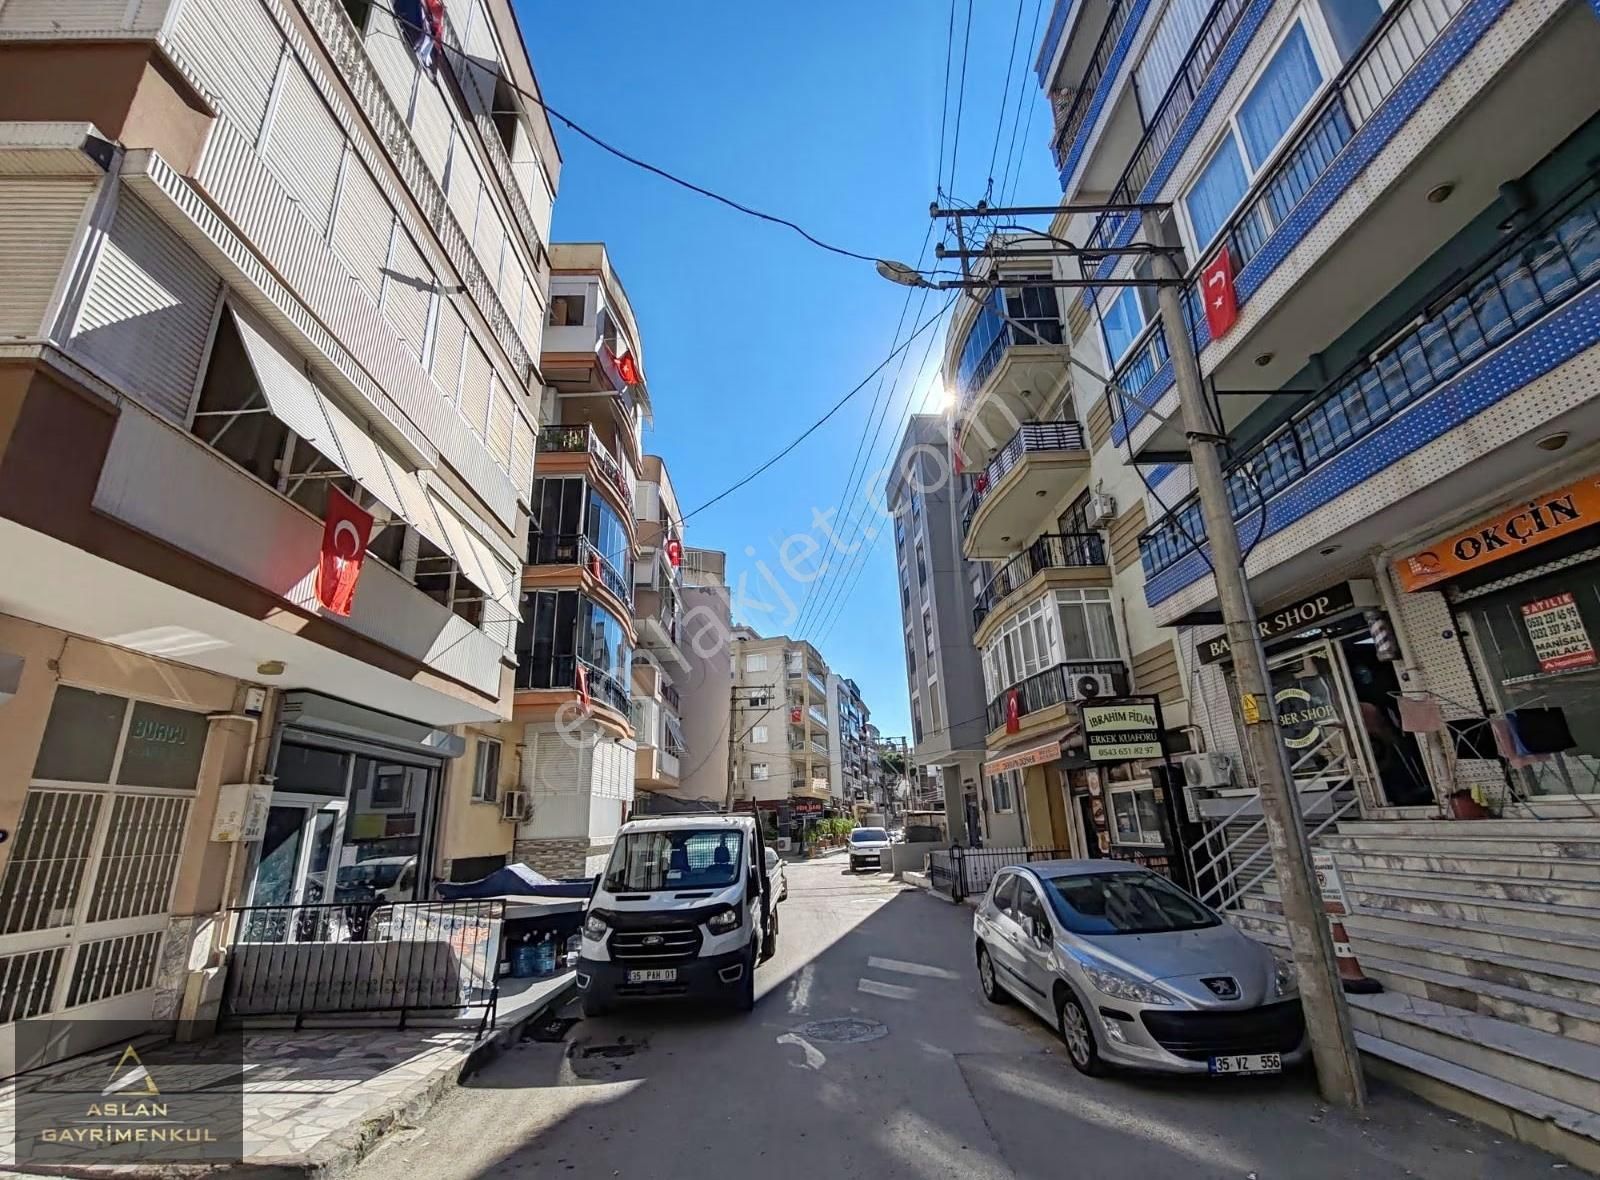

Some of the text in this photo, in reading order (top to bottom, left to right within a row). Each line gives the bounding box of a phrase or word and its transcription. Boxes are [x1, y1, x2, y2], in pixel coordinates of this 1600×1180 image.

[1454, 494, 1581, 561] OKÇİN
[1521, 594, 1571, 614] SATILIK
[1210, 596, 1329, 657] BAR SHOP
[1535, 633, 1586, 651] MANİSALI
[1539, 645, 1580, 659] EMLAK
[1088, 709, 1155, 728] İBRAHİM FİDAN
[1300, 705, 1334, 722] SHOP
[1090, 735, 1117, 744] ERKEK
[1144, 746, 1154, 754] 97
[631, 971, 641, 981] 35
[665, 970, 674, 979] 01
[1216, 1055, 1280, 1071] 35 VZ 556
